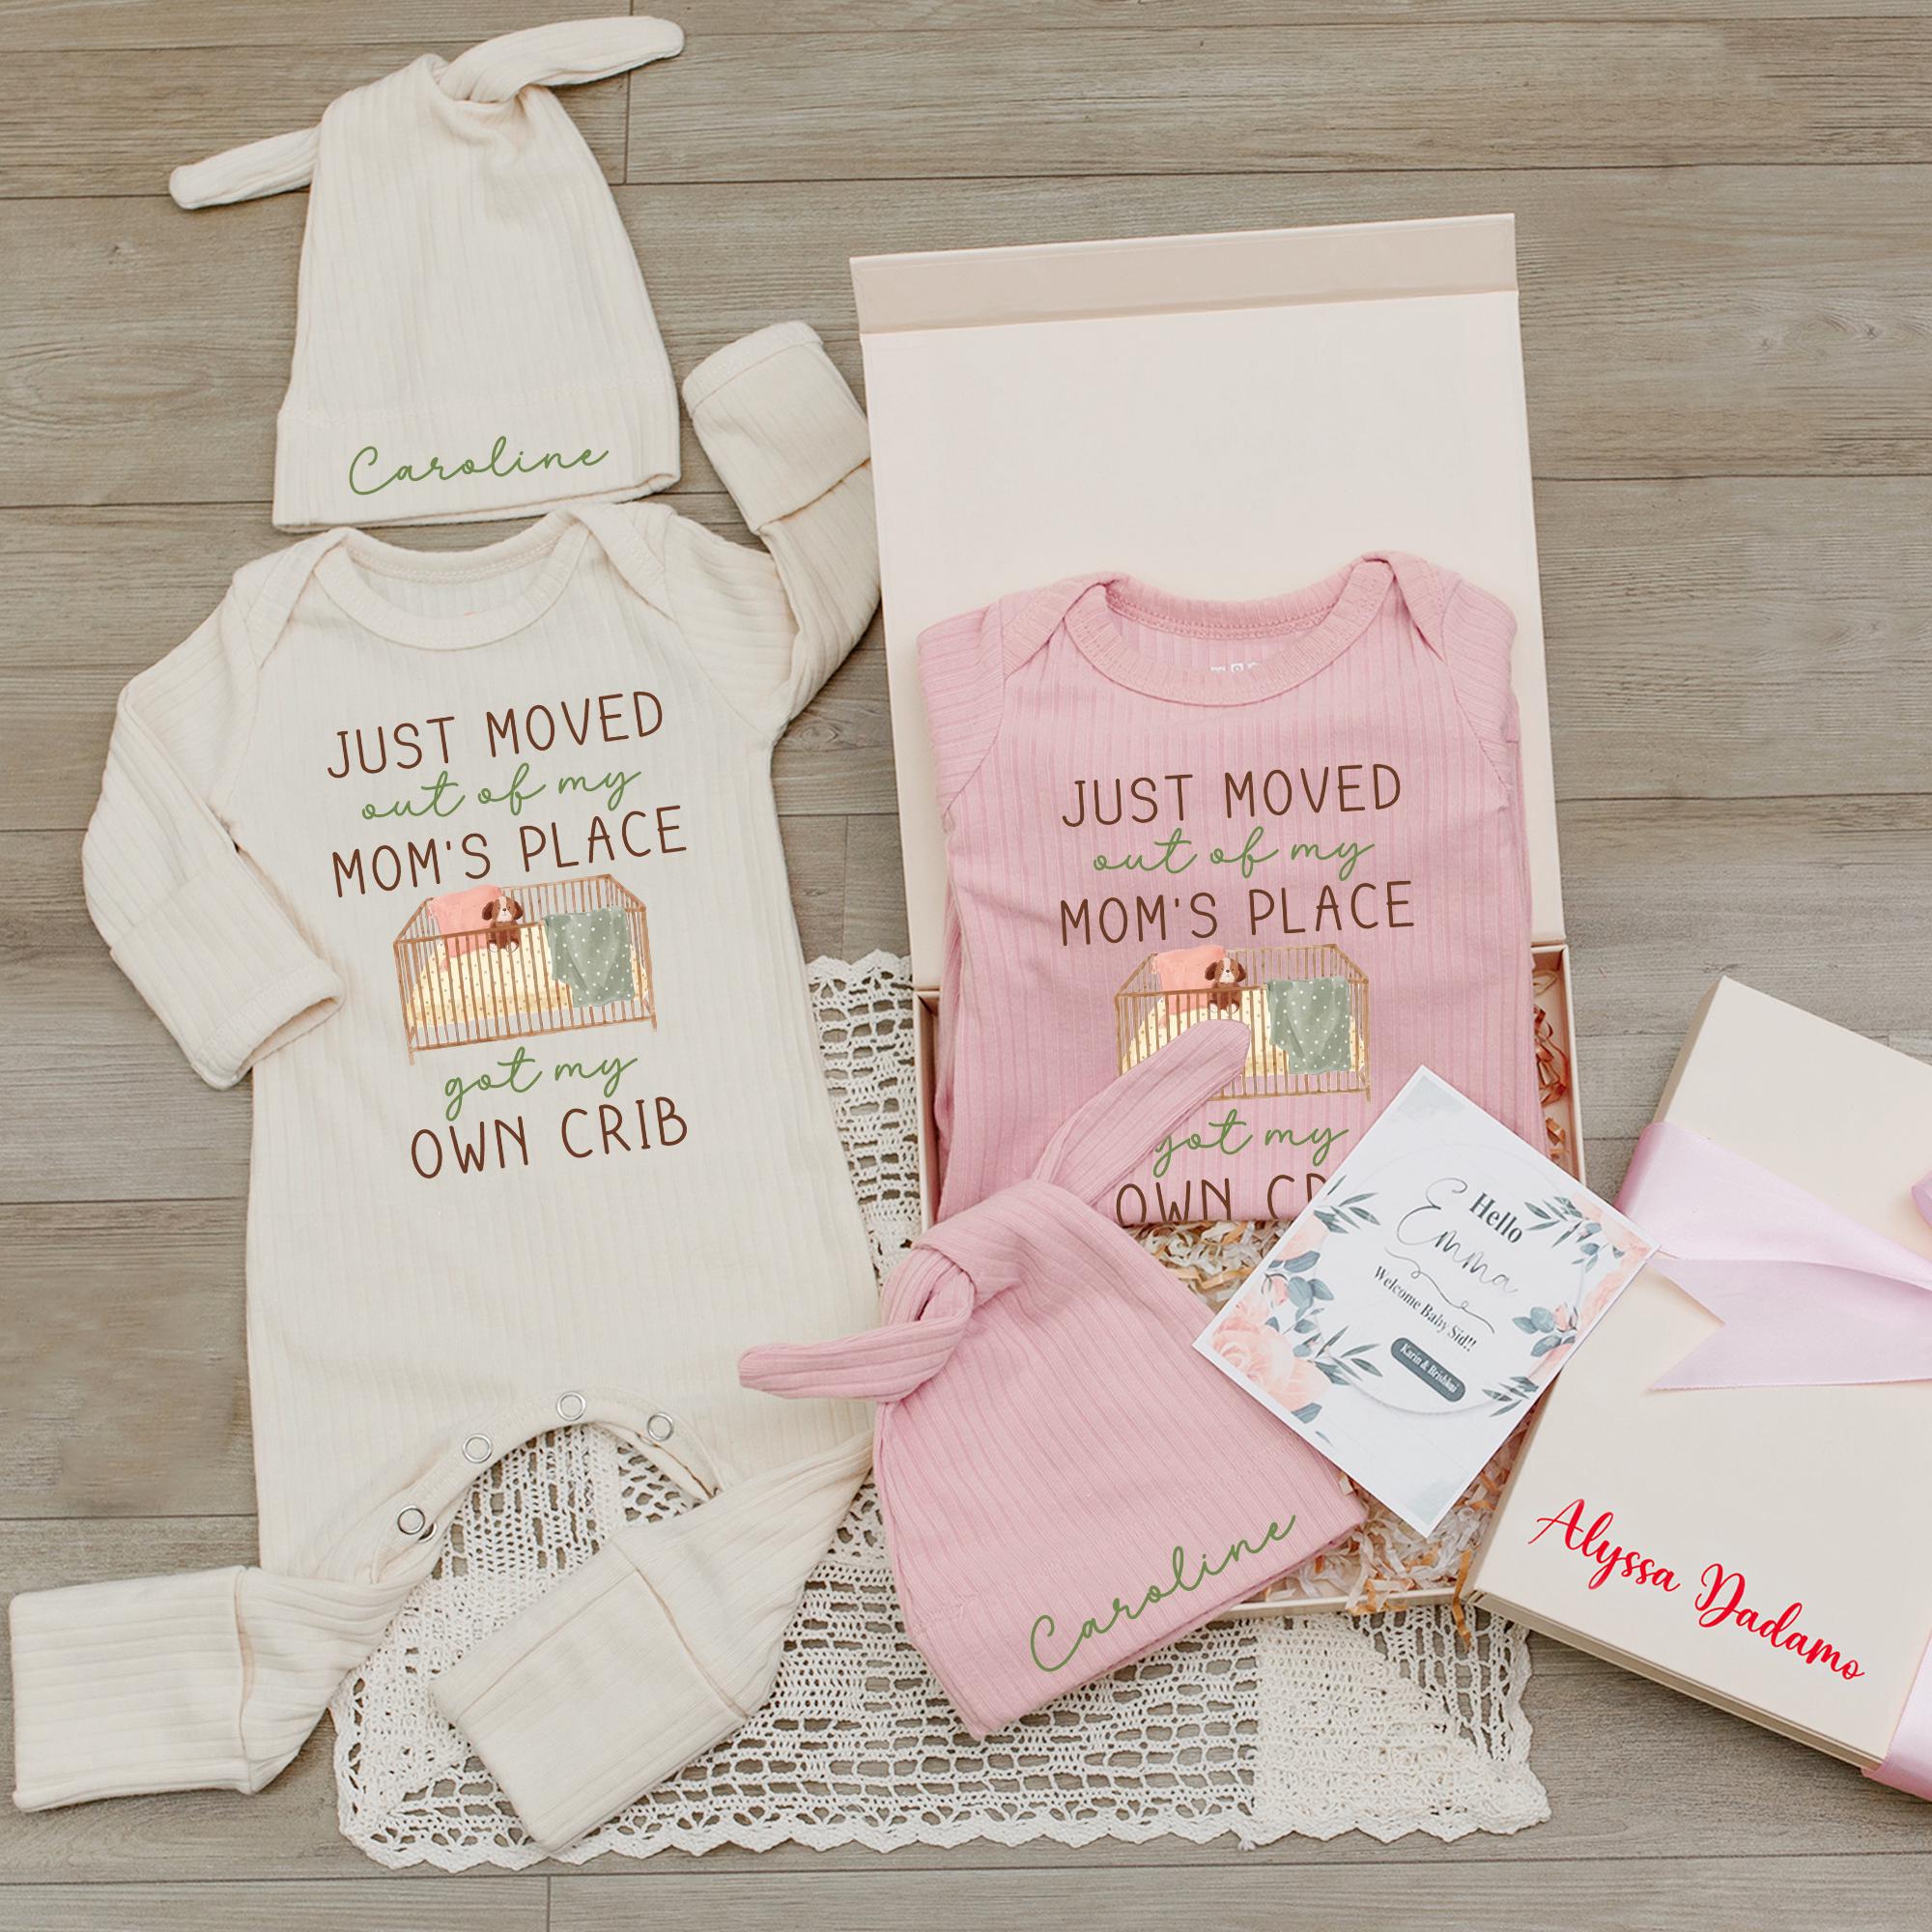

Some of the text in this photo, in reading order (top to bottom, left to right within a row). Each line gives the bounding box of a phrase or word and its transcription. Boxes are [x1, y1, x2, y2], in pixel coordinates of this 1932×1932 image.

[350, 436, 609, 496] Caroline
[327, 691, 663, 778] JUST MOVED
[361, 762, 641, 819] out of my
[1062, 763, 1401, 827] JUST MOVED
[331, 805, 688, 897] MOM'S PLACE
[1093, 826, 1376, 881] out of my
[1060, 880, 1415, 946] MOM'S PLACE
[444, 1046, 639, 1122] got my
[411, 1096, 688, 1179] OWN CRIB
[1264, 1126, 1350, 1167] my
[1116, 1178, 1231, 1224] OWN
[1396, 1177, 1519, 1293] Emma
[1468, 1192, 1523, 1244] Hello
[1375, 1265, 1477, 1351] Welcome Baby Sid!!
[1031, 1515, 1295, 1672] Caroline
[1527, 1498, 1865, 1680] Alyssa Dadamo
